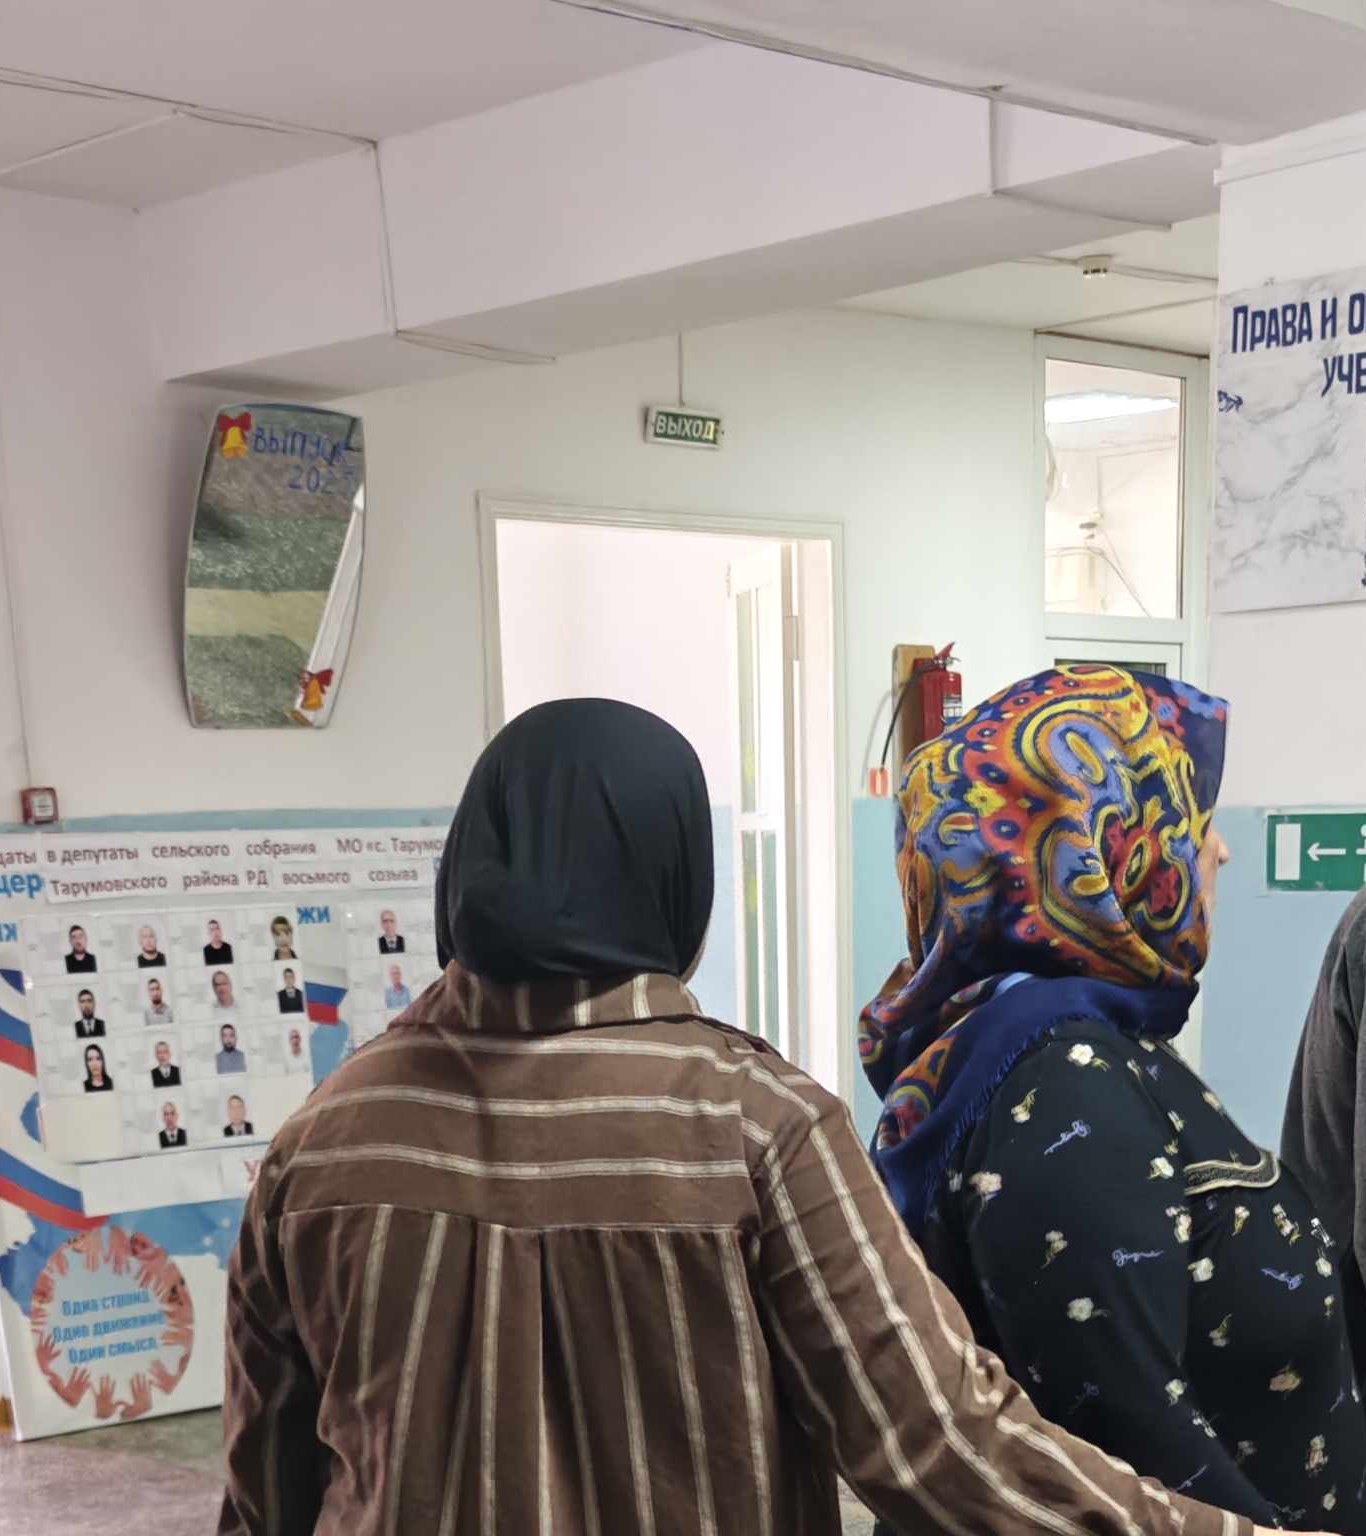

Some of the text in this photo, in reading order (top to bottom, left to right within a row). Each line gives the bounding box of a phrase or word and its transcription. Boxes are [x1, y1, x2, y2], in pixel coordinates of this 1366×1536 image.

[1320, 296, 1338, 341] И
[655, 413, 716, 442] ВЫХОД
[47, 850, 57, 863] в
[62, 847, 139, 866] депутаты
[151, 843, 230, 859] сельского
[246, 839, 317, 859] собрания
[337, 838, 363, 854] МО
[390, 836, 443, 855] Тарумо
[51, 876, 168, 897] Тарумовского
[183, 870, 239, 891] района
[246, 870, 269, 887] РД
[282, 870, 351, 886] восьмого
[368, 868, 419, 882] созыва
